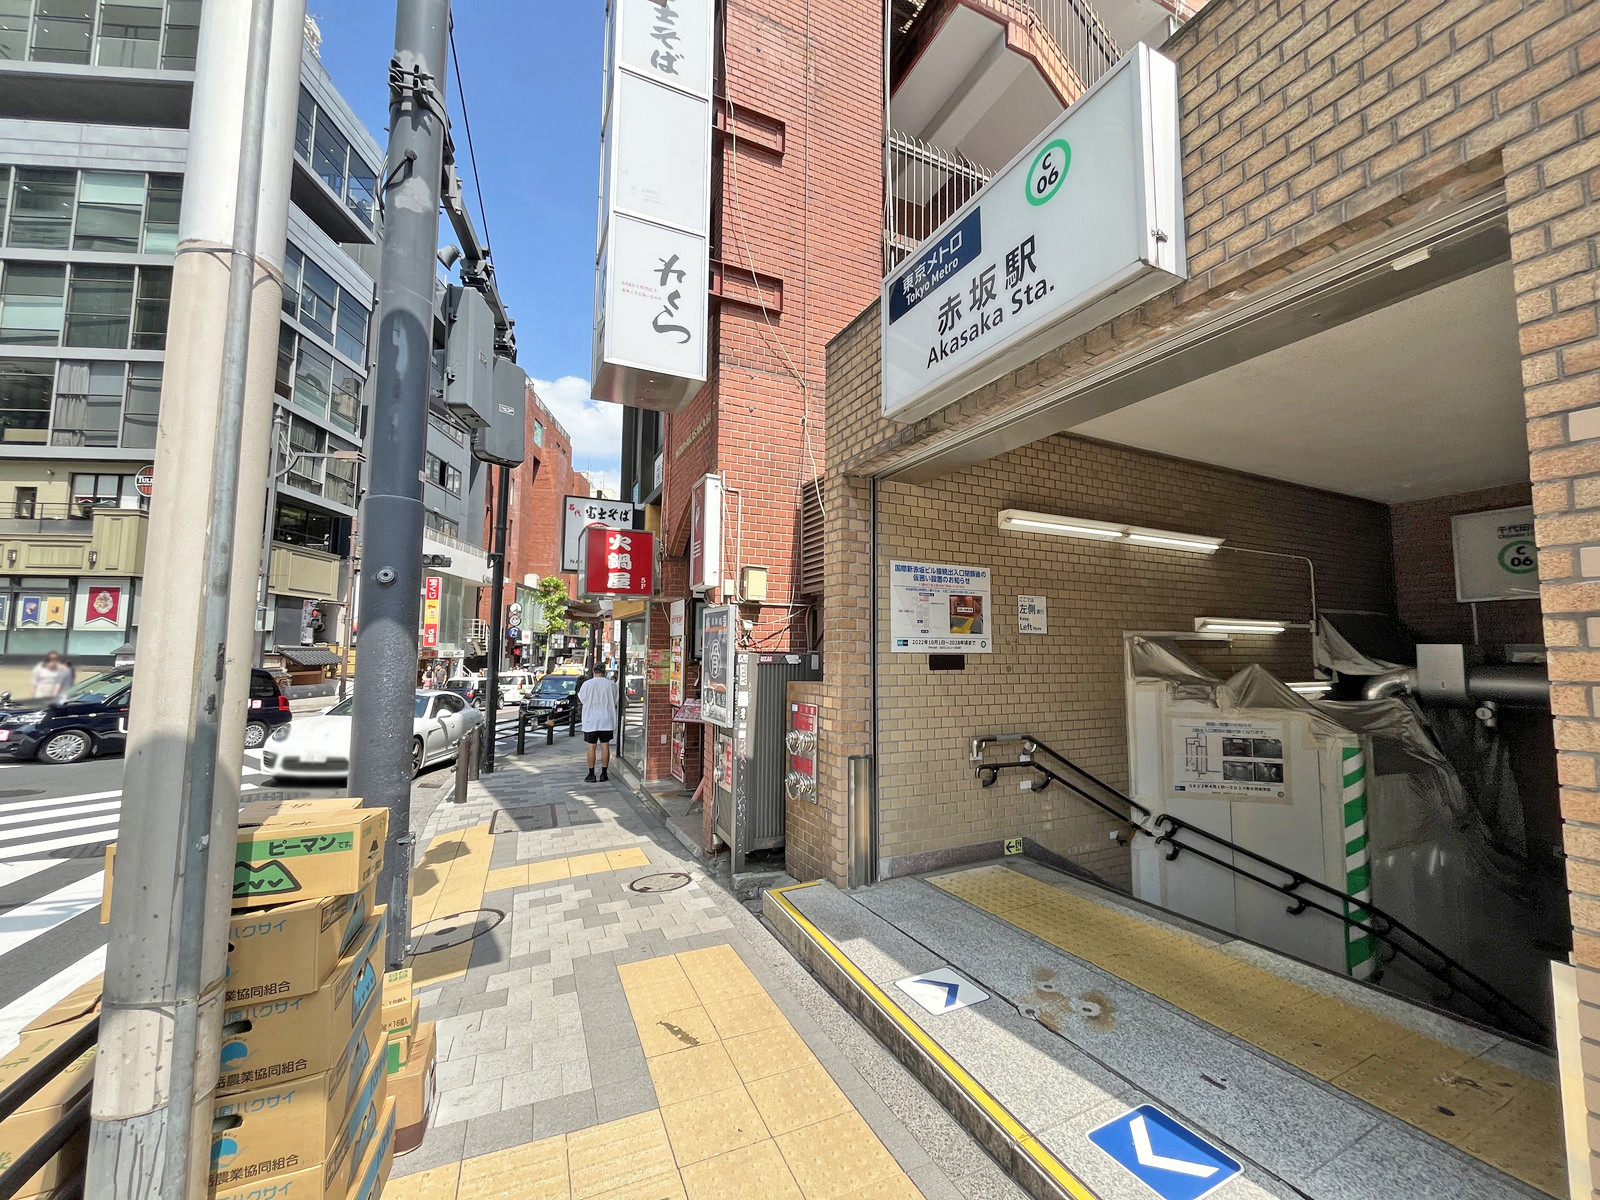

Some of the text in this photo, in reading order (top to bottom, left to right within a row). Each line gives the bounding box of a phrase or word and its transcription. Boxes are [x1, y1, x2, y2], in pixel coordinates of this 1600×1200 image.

[1042, 152, 1052, 171] C
[1036, 167, 1059, 194] 06
[902, 230, 963, 296] 東京メトロ
[906, 258, 959, 306] Tokyo Metro
[937, 234, 1037, 336] 赤坂駅
[927, 277, 1055, 369] Akasaka Sta.
[586, 506, 631, 522] 富士そば
[607, 534, 632, 589] 火鍋屋
[1511, 556, 1533, 567] 06
[1516, 546, 1526, 555] C
[1020, 622, 1032, 631] Left
